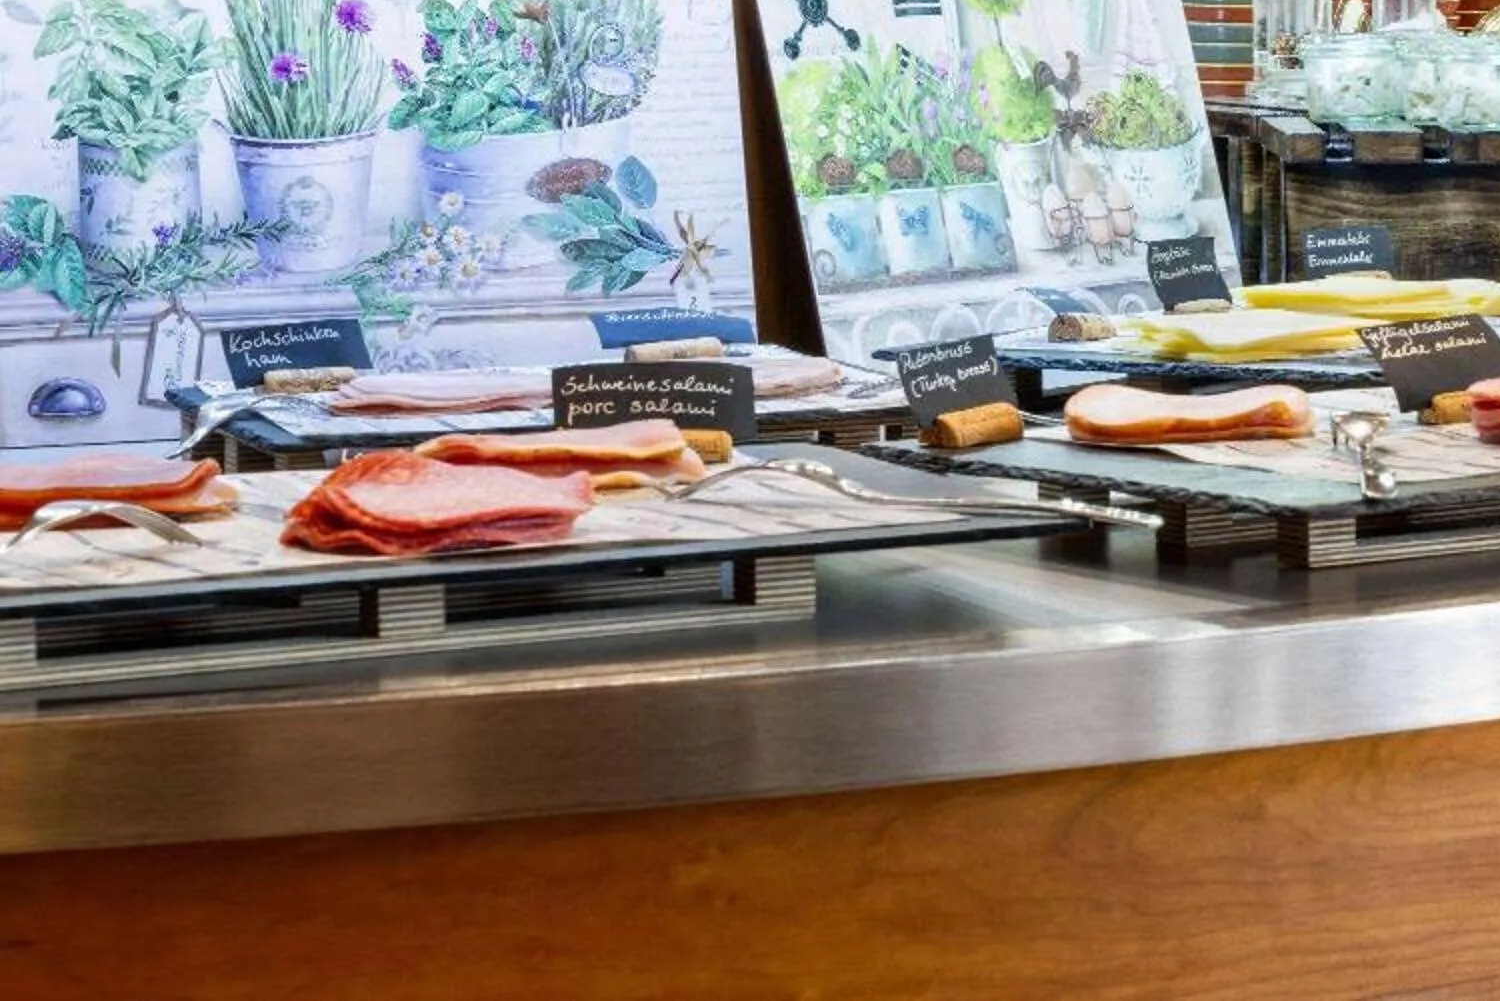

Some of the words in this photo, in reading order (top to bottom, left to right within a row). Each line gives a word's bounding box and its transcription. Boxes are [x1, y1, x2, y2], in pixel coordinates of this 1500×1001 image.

[244, 352, 292, 368] ham
[561, 373, 736, 396] Schweinesalami
[567, 400, 616, 424] porc
[629, 398, 719, 417] salami
